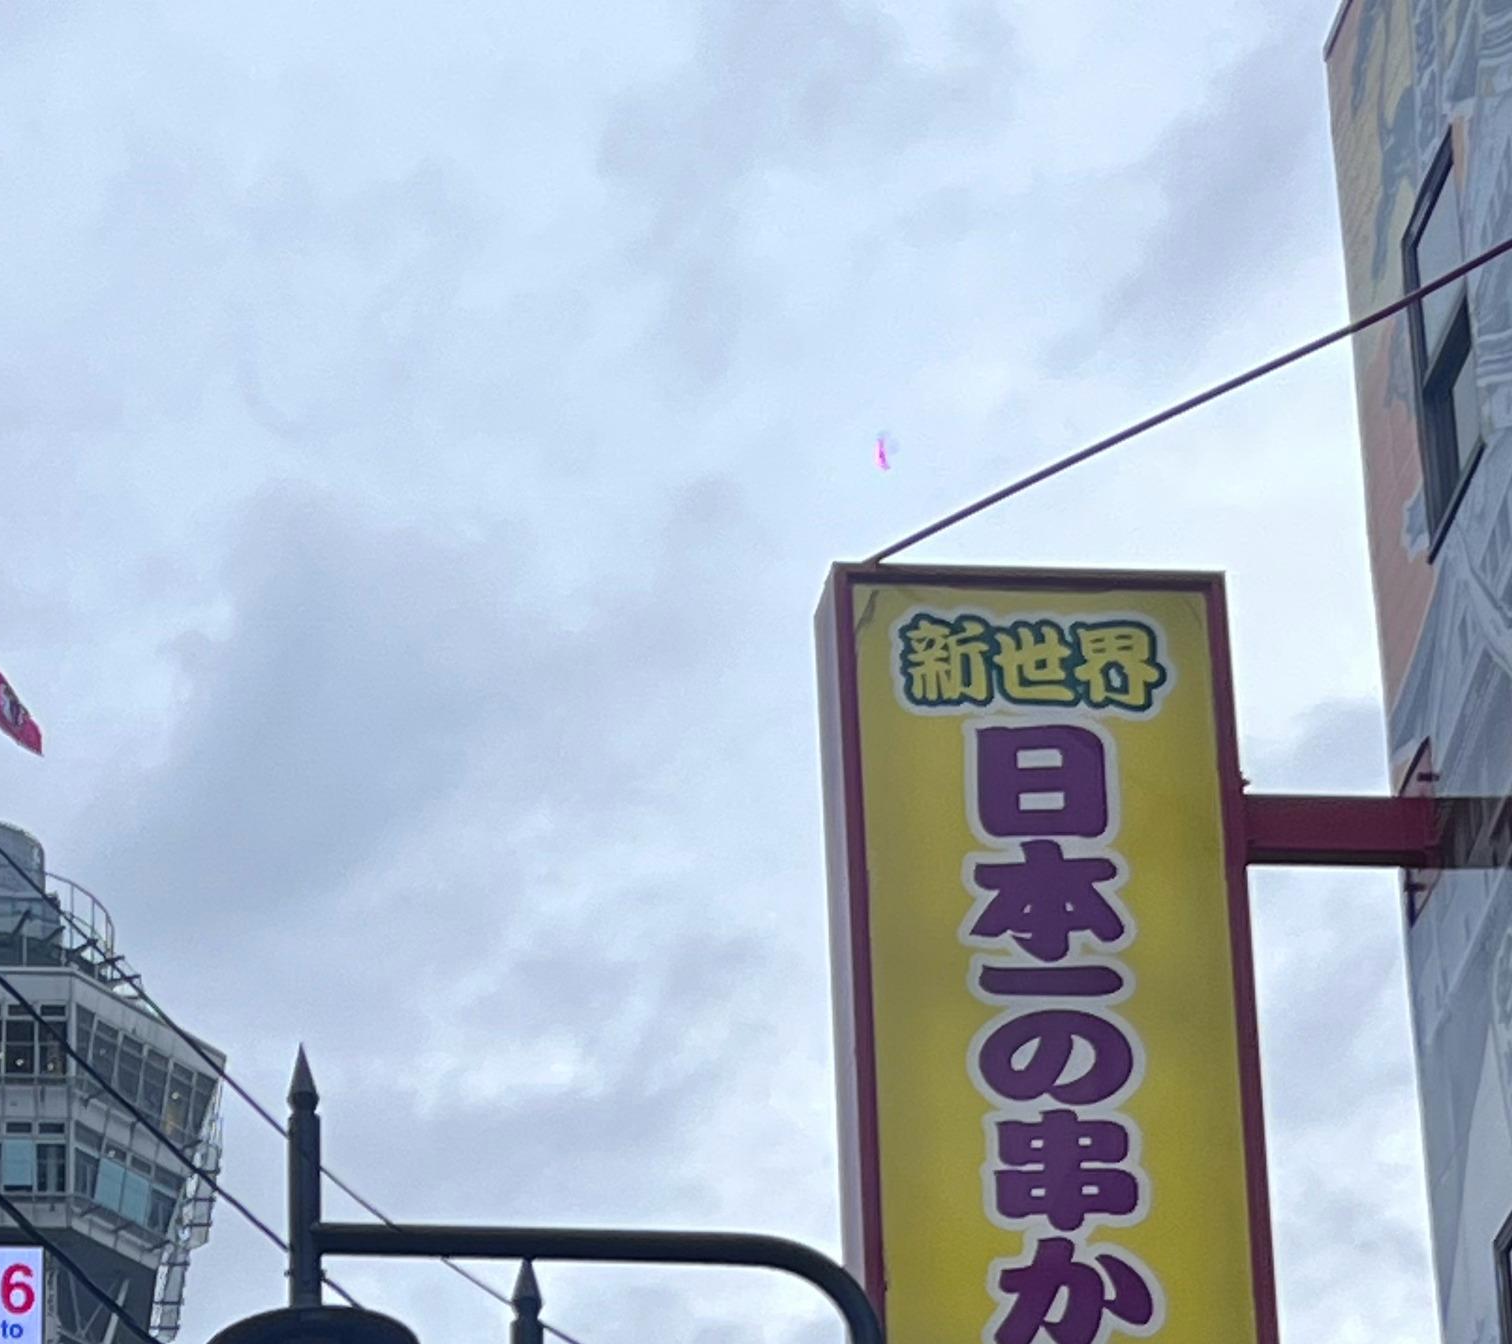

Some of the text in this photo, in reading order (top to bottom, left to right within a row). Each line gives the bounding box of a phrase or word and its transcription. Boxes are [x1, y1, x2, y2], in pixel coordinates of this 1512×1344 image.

[902, 613, 1166, 711] 新世界
[1, 1320, 24, 1339] to
